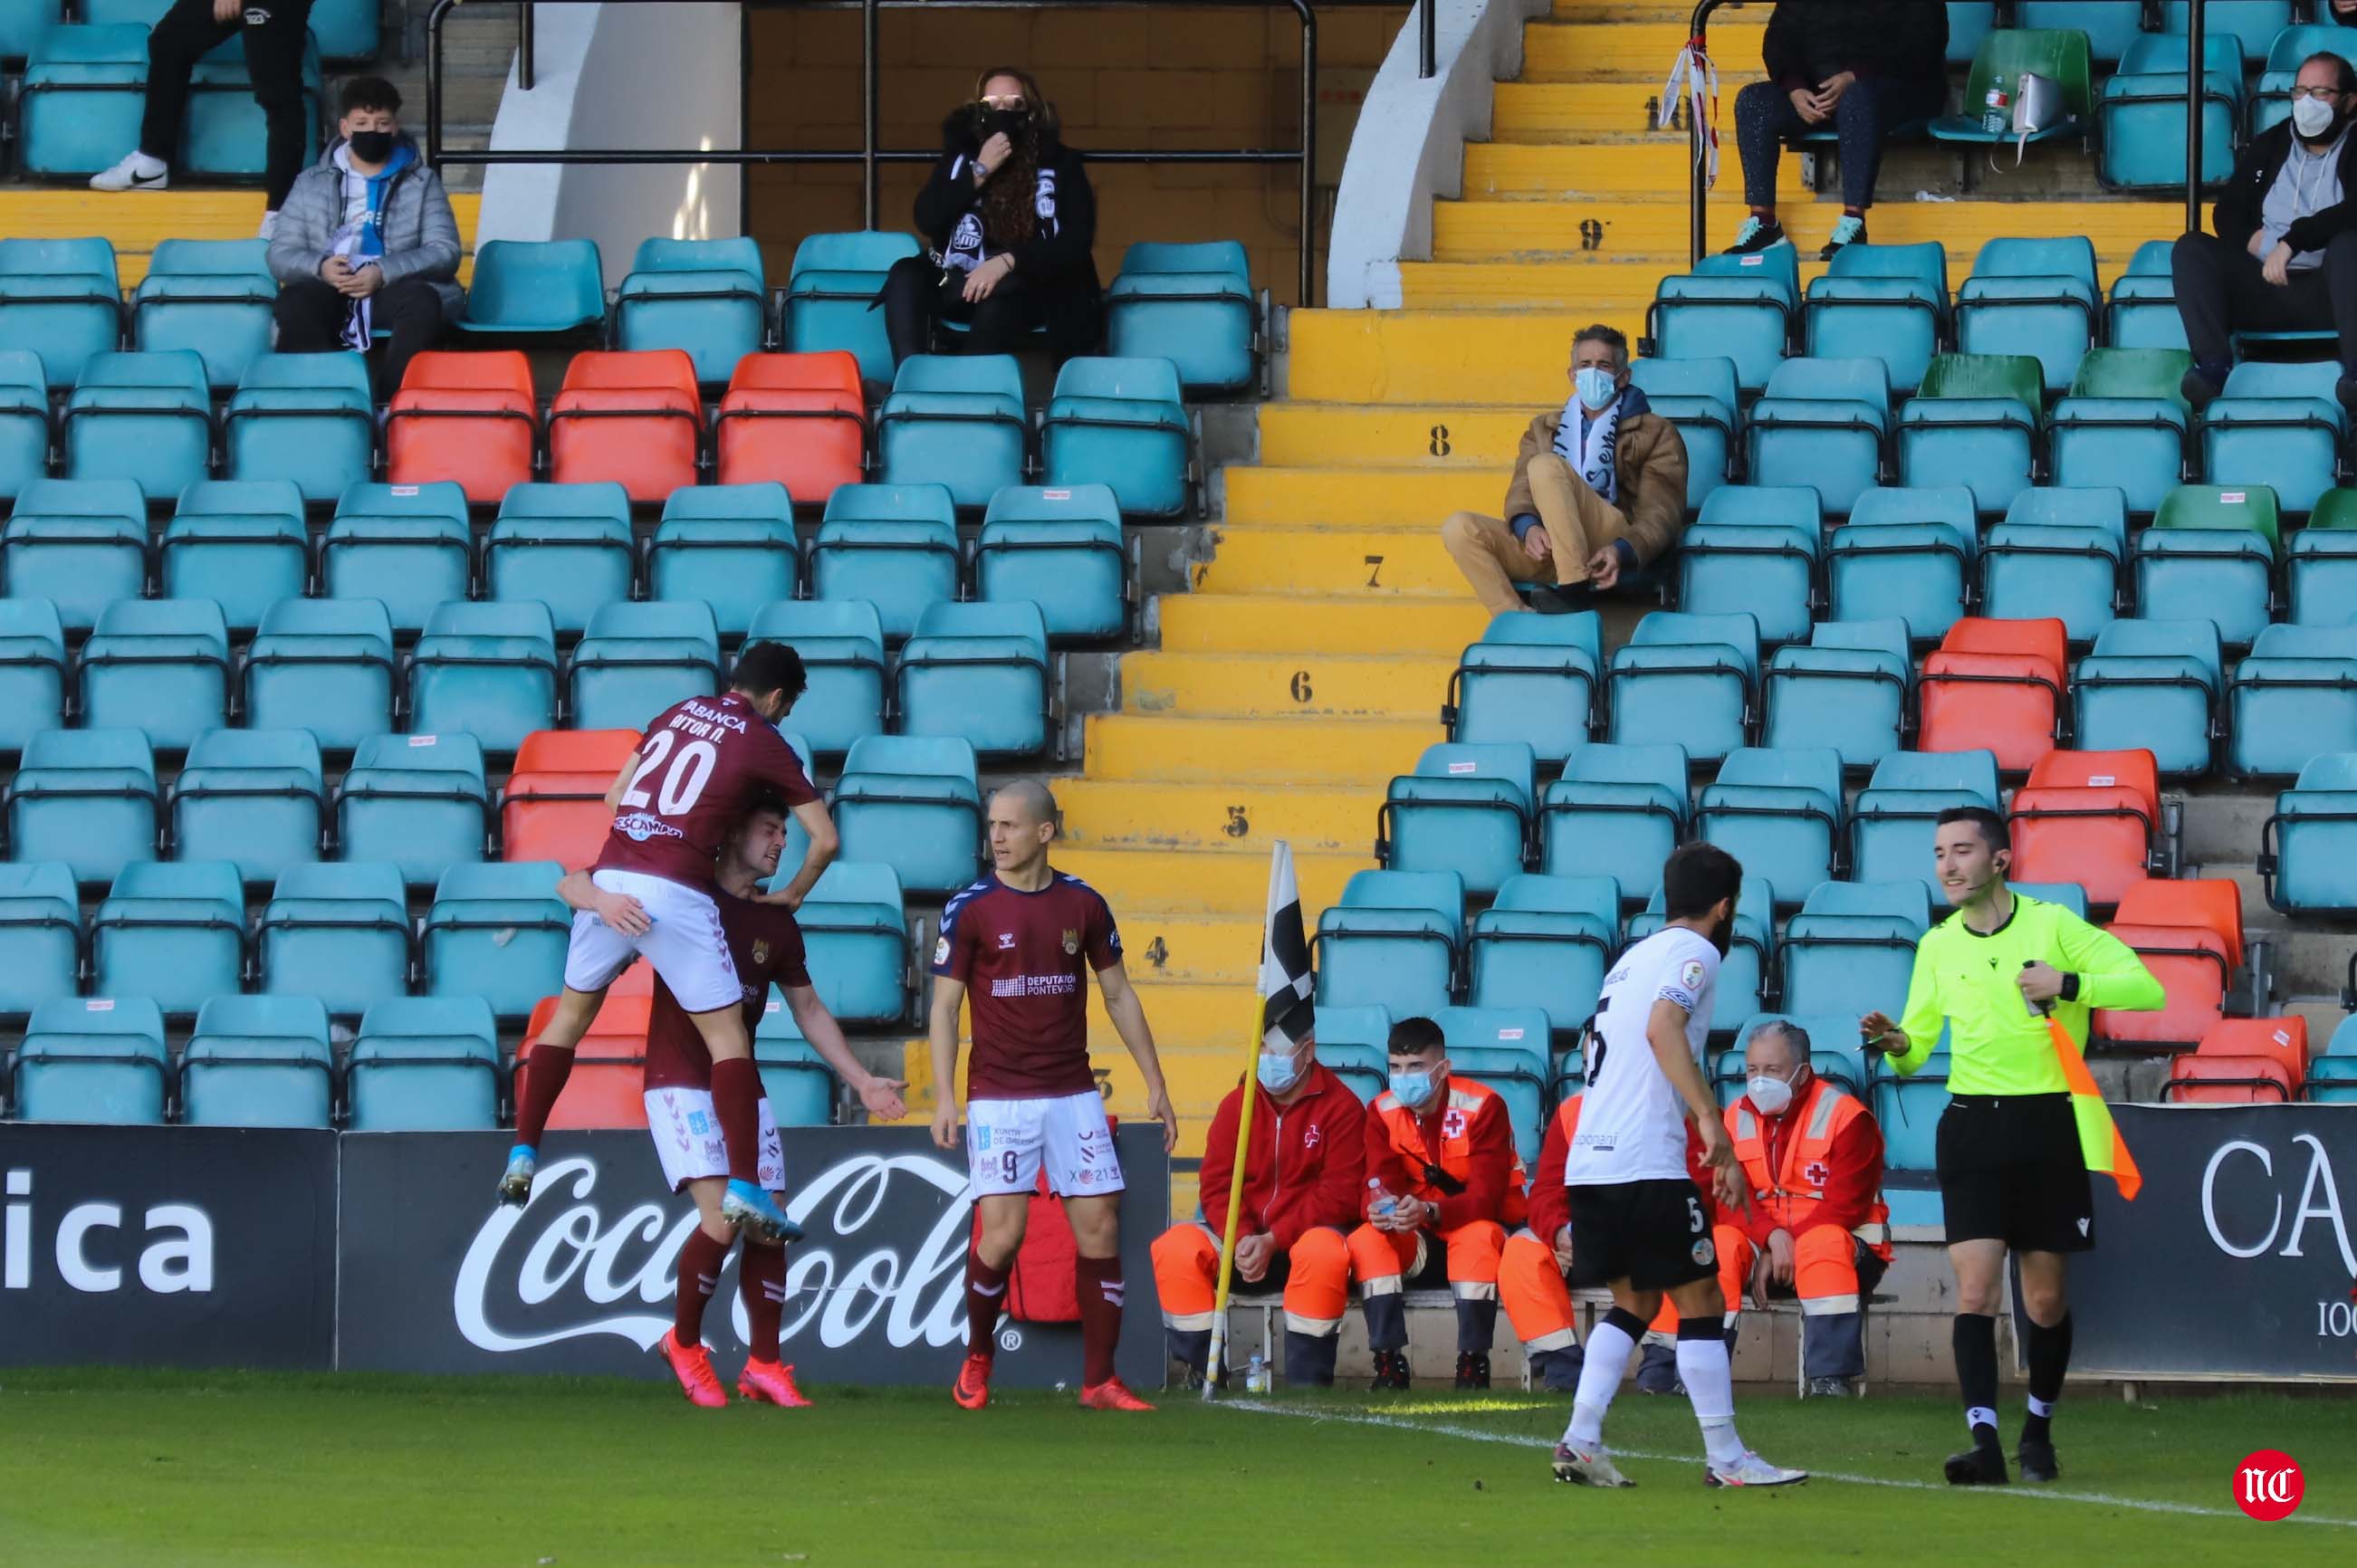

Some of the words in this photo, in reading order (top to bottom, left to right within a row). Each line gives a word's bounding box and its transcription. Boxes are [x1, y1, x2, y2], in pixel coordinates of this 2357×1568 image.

[1579, 218, 1602, 251] 9
[1430, 425, 1451, 456] 8
[1365, 555, 1384, 587] 7
[1290, 671, 1312, 703] 6
[668, 714, 713, 737] AITOR
[684, 701, 747, 734] ABANCA
[620, 730, 716, 816] 20
[1227, 806, 1249, 837] 5
[1145, 936, 1169, 967] 4
[1002, 1150, 1018, 1184] 9
[1095, 1168, 1108, 1181] 21
[1687, 1197, 1703, 1232] 5
[2202, 1133, 2357, 1279] CA
[5, 1171, 212, 1293] ica
